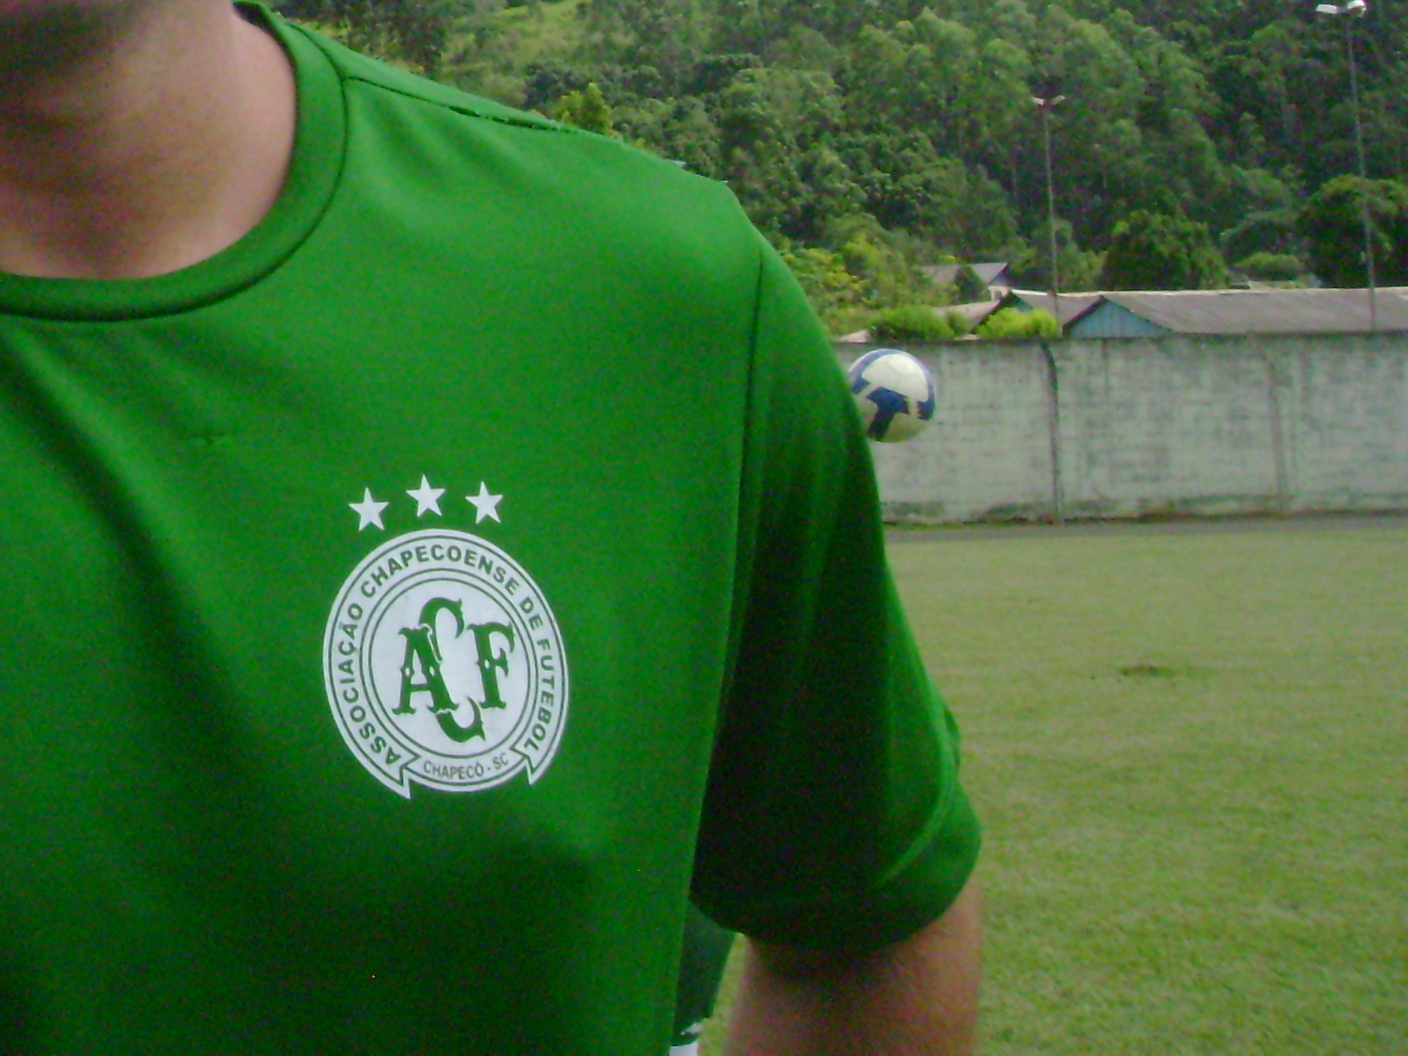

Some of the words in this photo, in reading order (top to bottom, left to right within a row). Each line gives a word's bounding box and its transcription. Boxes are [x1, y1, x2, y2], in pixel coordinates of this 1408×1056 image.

[360, 543, 520, 598] CHAPECOENSE
[519, 597, 544, 631] DE
[338, 602, 402, 766] ASSOCIAÇÃO
[523, 638, 556, 752] FUTEBOL
[492, 752, 509, 770] SC
